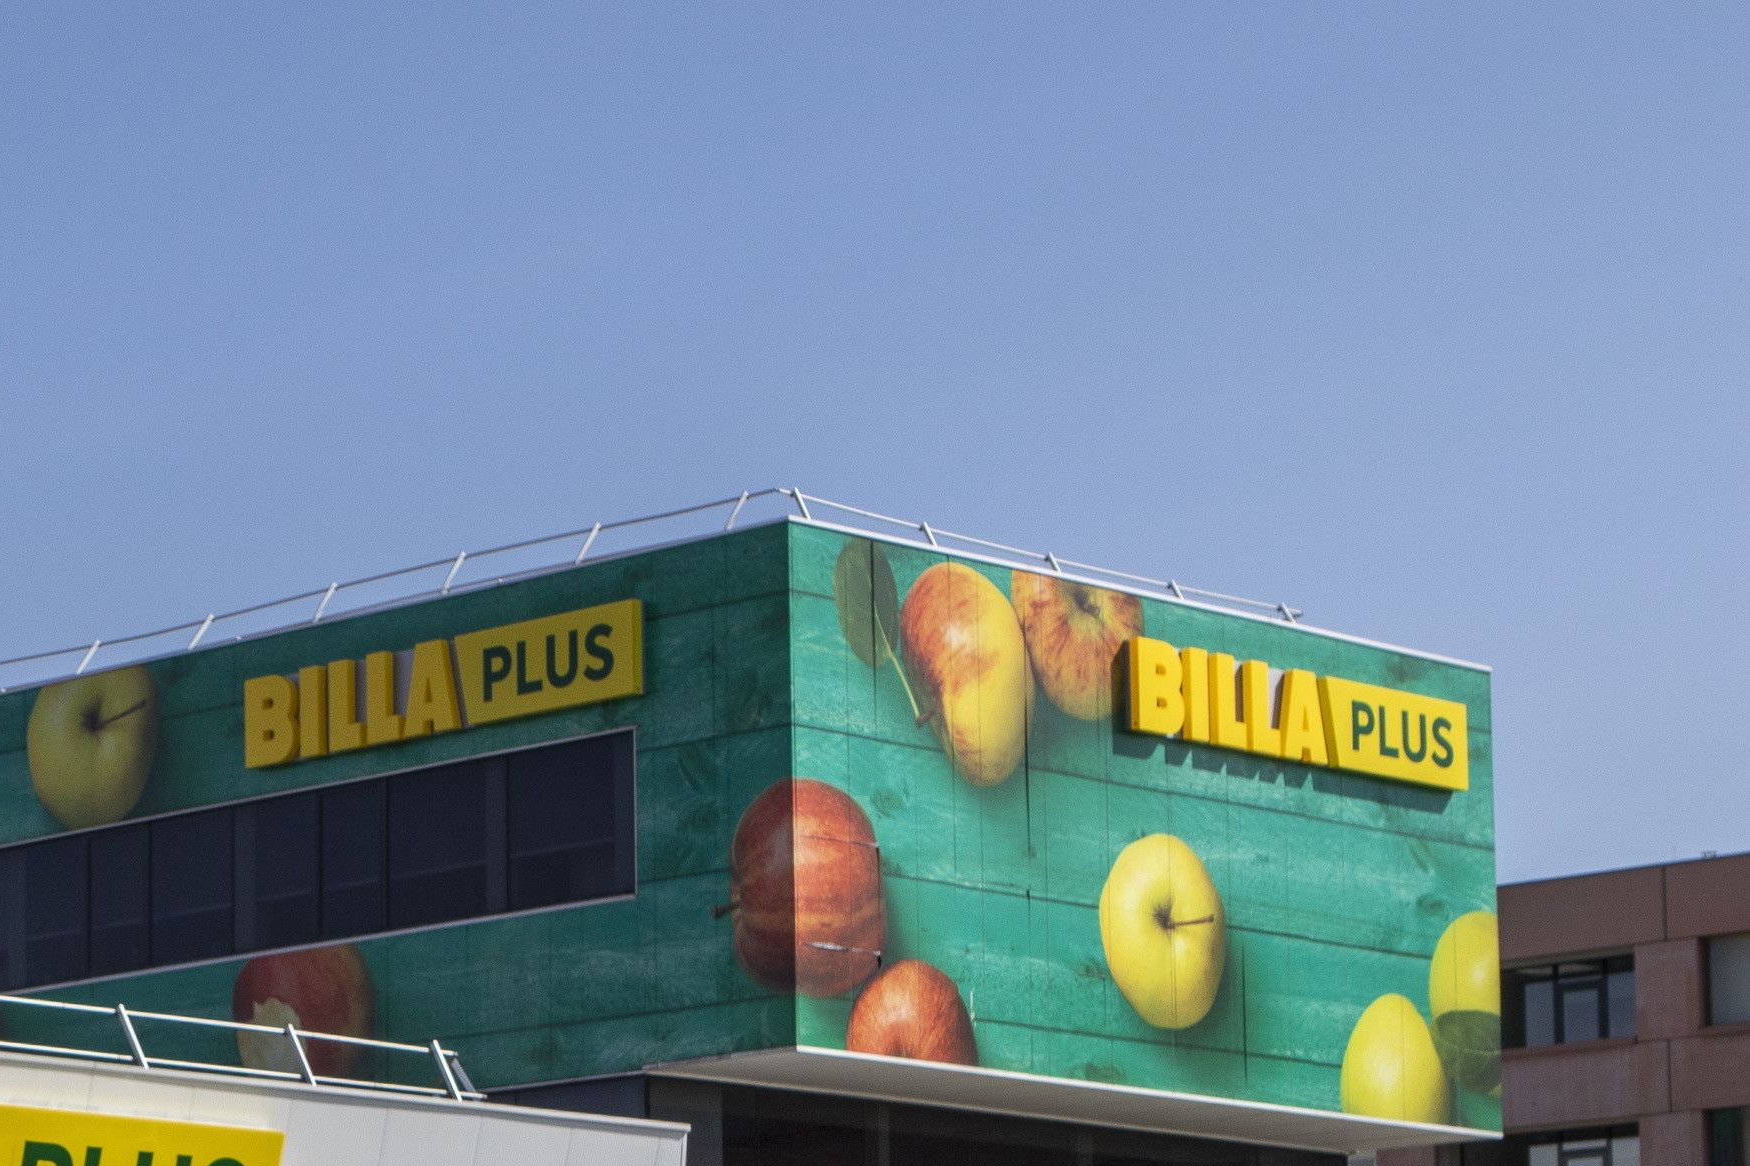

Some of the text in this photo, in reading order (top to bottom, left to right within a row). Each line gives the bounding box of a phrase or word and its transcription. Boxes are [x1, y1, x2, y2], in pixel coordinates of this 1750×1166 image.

[244, 623, 614, 768] BILLA PLUS
[1130, 636, 1455, 769] BILLA PLUS
